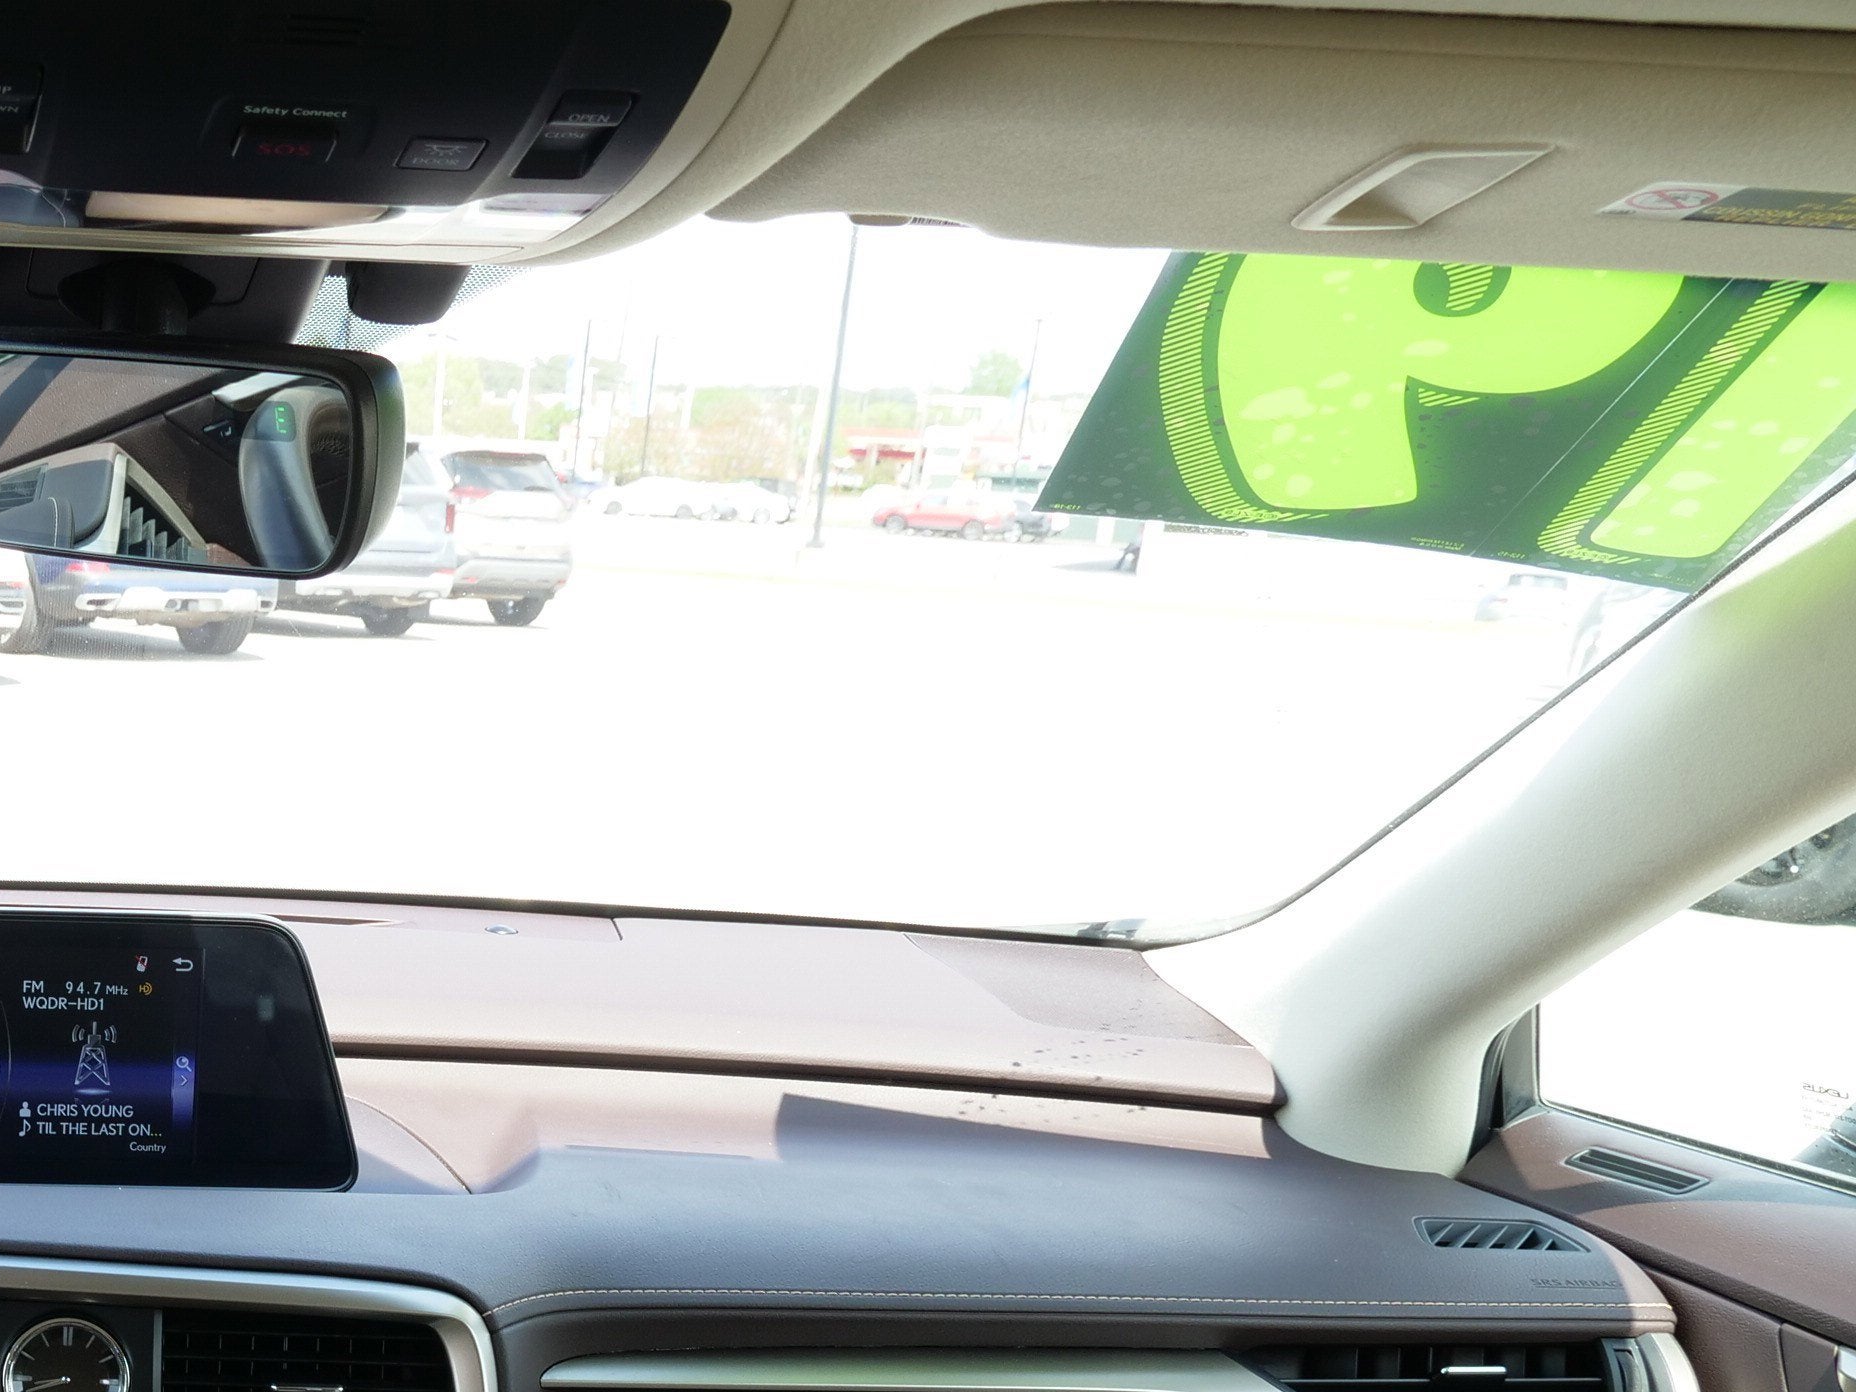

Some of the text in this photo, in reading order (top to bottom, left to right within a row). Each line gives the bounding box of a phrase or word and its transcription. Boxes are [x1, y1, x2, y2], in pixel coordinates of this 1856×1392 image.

[244, 105, 347, 118] Safety Connect
[568, 114, 610, 123] OPEN
[544, 131, 586, 140] CLOSE
[257, 143, 312, 156] SOS
[23, 980, 44, 993] FM
[65, 981, 101, 994] 94.7
[106, 985, 129, 996] MHz
[23, 997, 104, 1011] WQDR-HD1
[37, 1103, 134, 1118] CHRIS YOUNG
[36, 1122, 56, 1135] TIL
[60, 1122, 88, 1135] THE
[91, 1123, 125, 1136] LAST
[129, 1142, 166, 1153] Country
